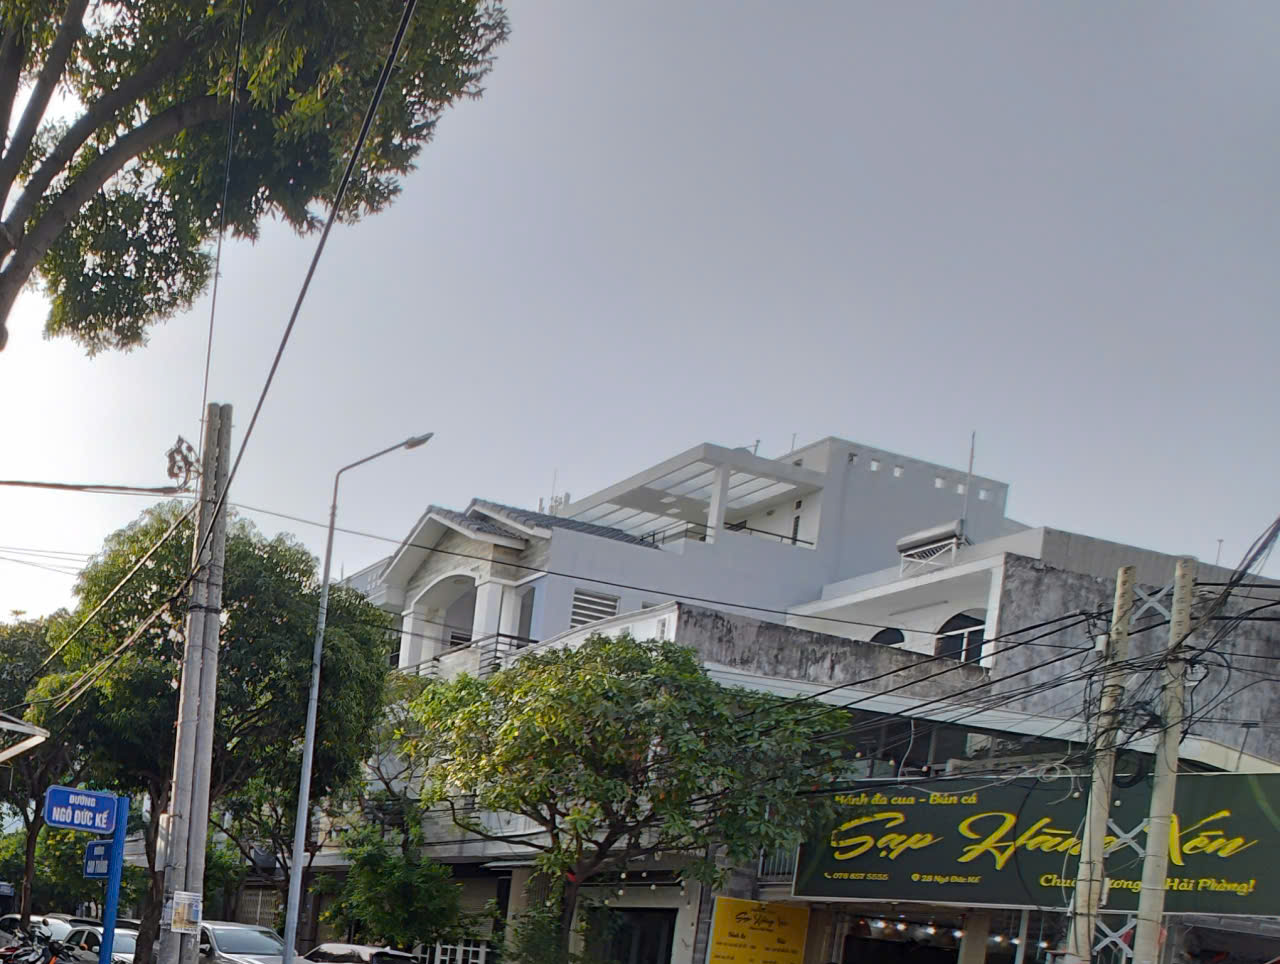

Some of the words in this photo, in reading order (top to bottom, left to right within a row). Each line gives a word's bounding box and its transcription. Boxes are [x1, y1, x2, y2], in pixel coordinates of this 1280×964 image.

[69, 794, 96, 807] ĐƯỜNG
[871, 792, 889, 805] đa
[890, 795, 916, 805] cua
[928, 792, 959, 805] Bún
[960, 793, 978, 805] cá
[52, 806, 72, 823] NGÔ
[74, 808, 93, 826] ĐỨC
[95, 810, 110, 828] KẾ
[830, 811, 945, 861] Sạp
[1165, 877, 1195, 892] Hải
[1196, 877, 1256, 896] Phòng!
